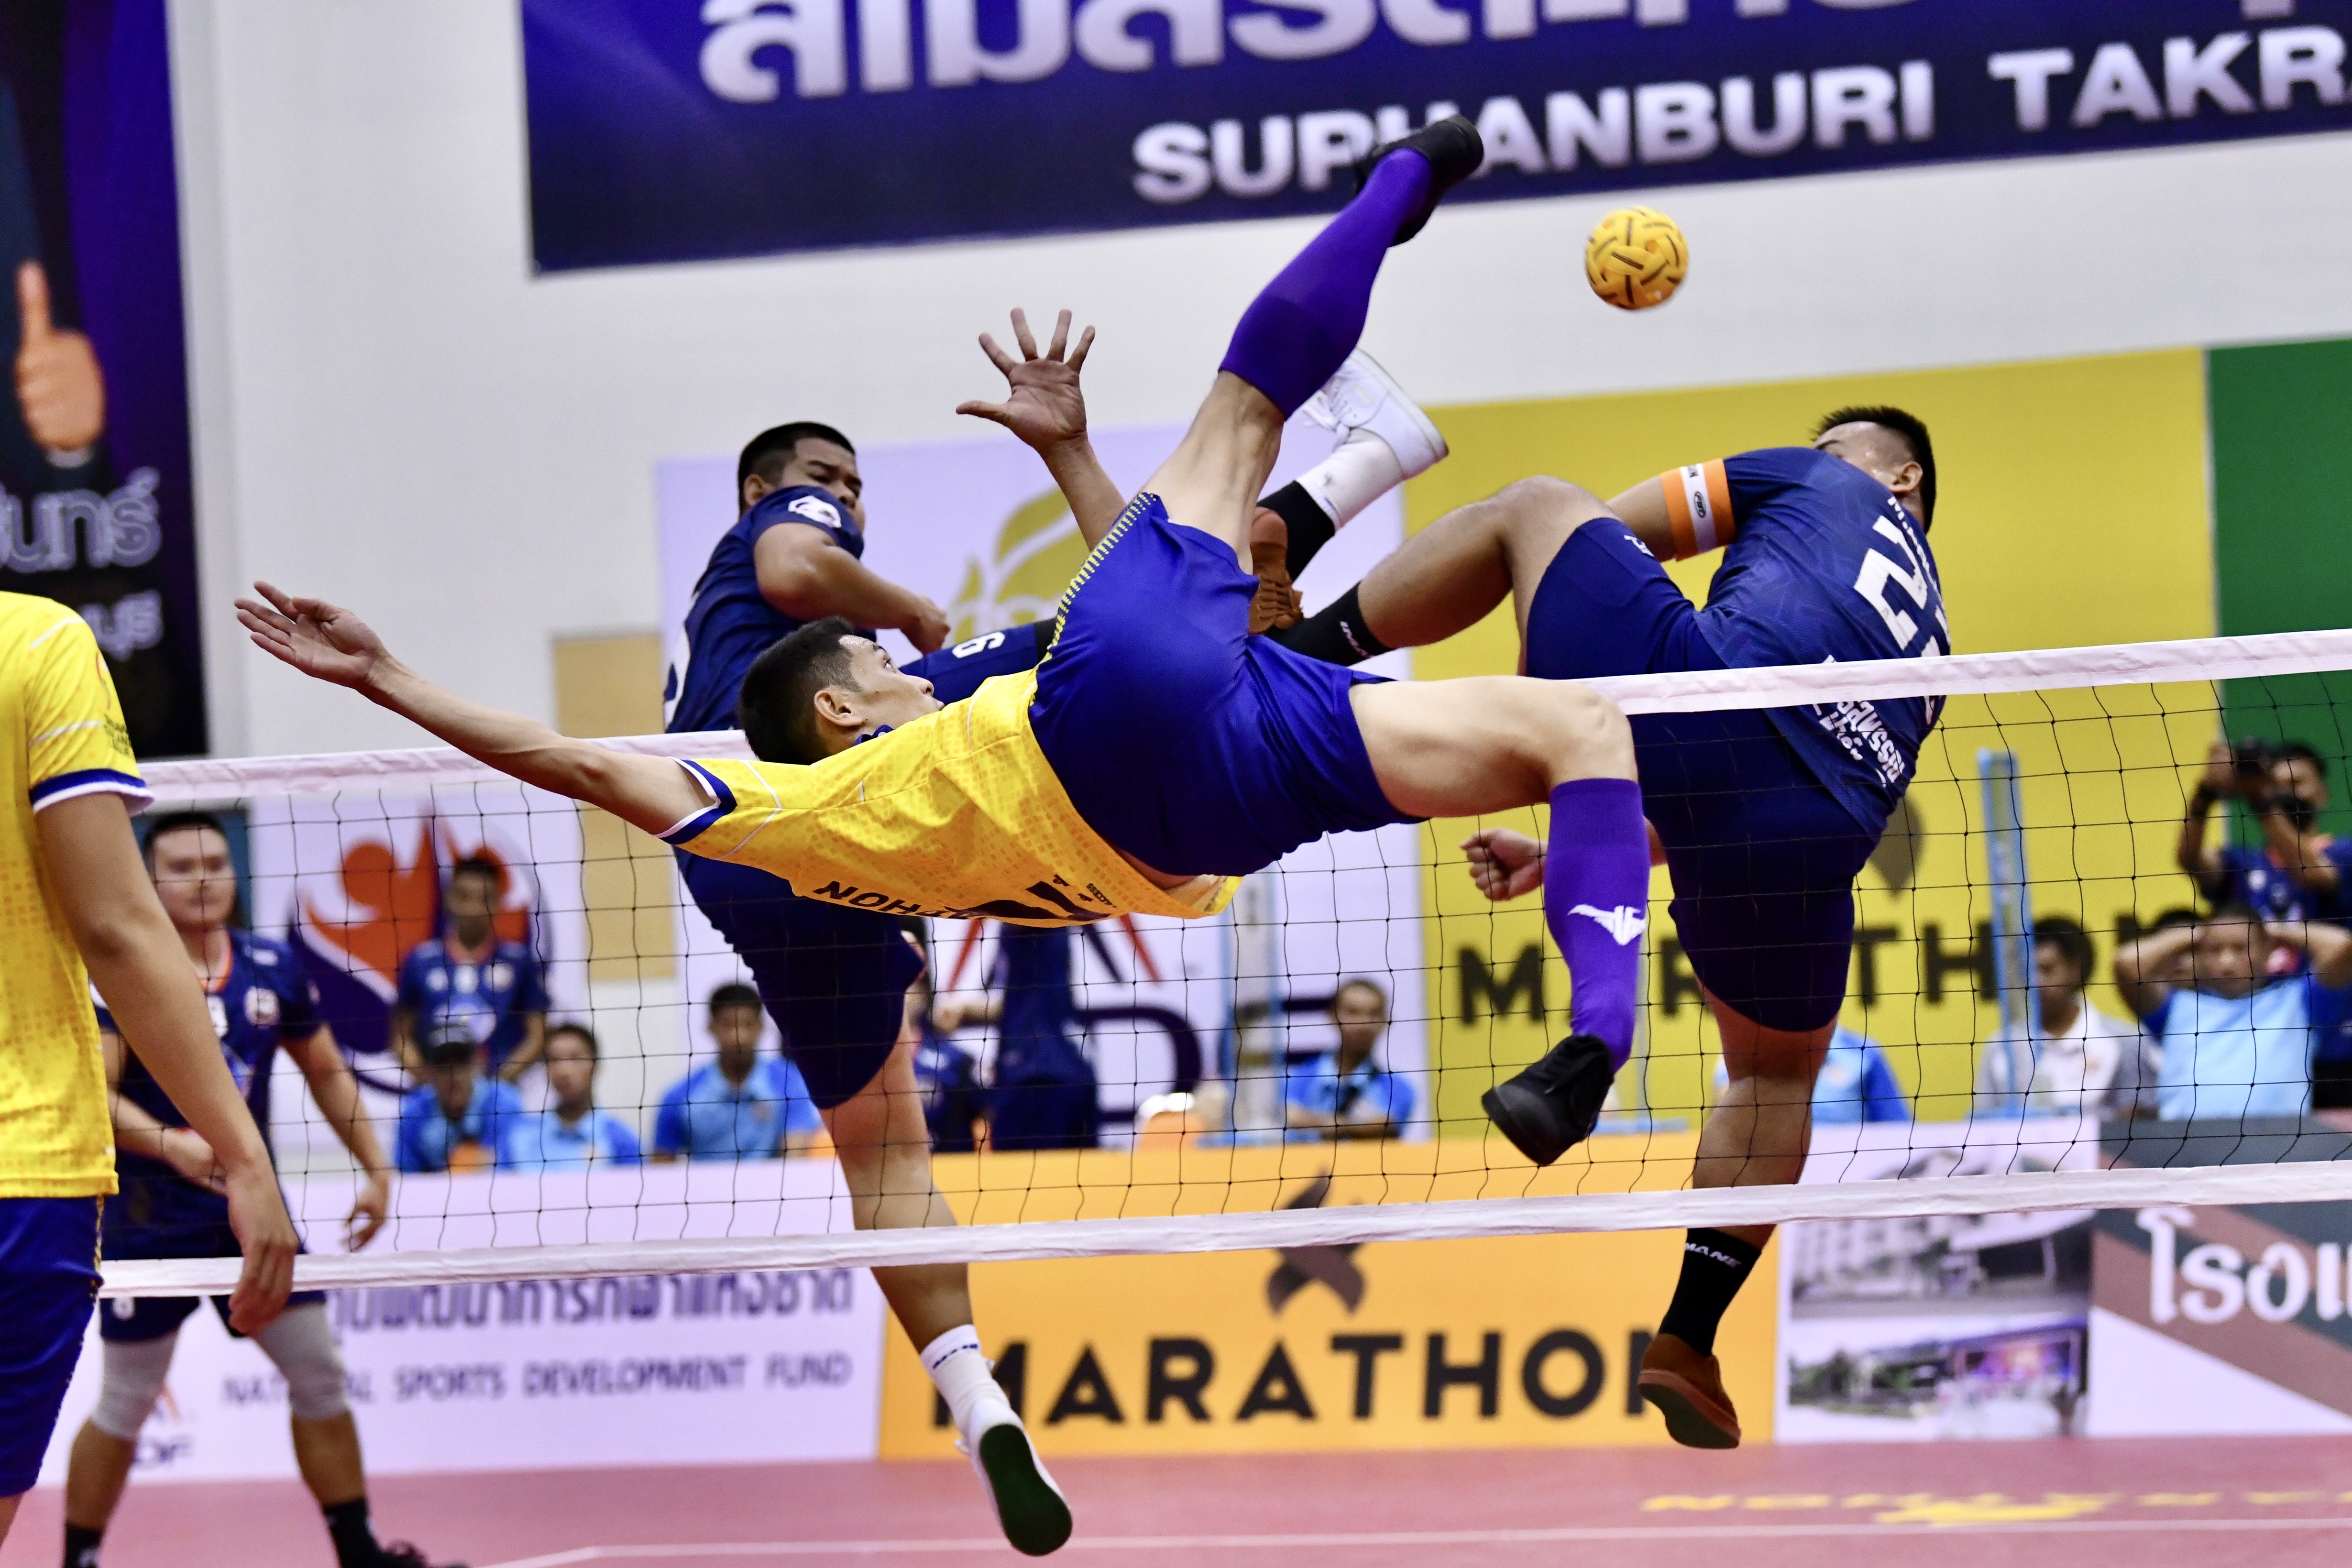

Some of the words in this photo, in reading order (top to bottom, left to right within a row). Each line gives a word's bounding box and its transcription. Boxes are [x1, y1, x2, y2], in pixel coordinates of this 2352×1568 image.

[1987, 24, 2352, 132] TAKR
[393, 1360, 508, 1400] SPORTS
[523, 1352, 749, 1397] DEVELOPMENT
[765, 1349, 852, 1389] FUND
